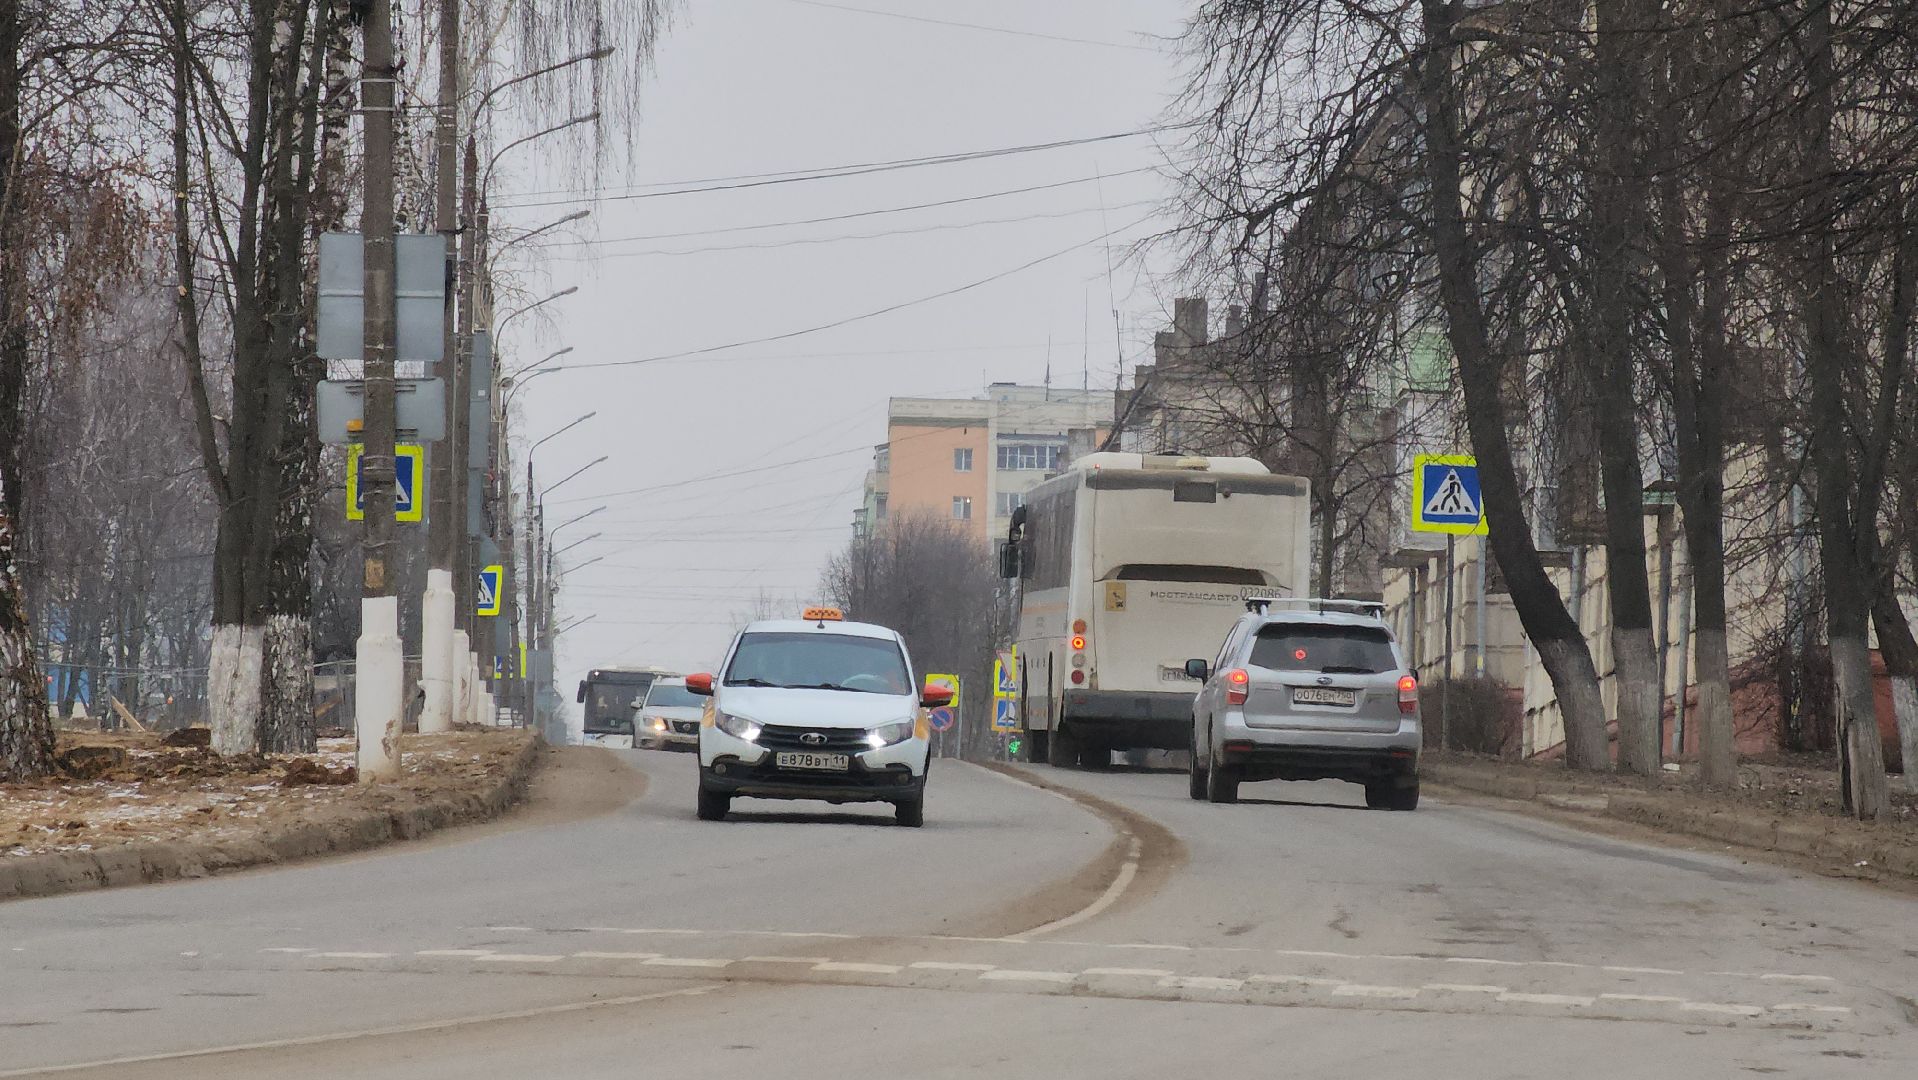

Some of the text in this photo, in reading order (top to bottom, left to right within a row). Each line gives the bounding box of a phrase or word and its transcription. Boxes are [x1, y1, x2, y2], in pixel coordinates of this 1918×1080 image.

[1150, 586, 1281, 601] МОСТРАНСАВТО 032086
[781, 754, 829, 766] Е878ВТ
